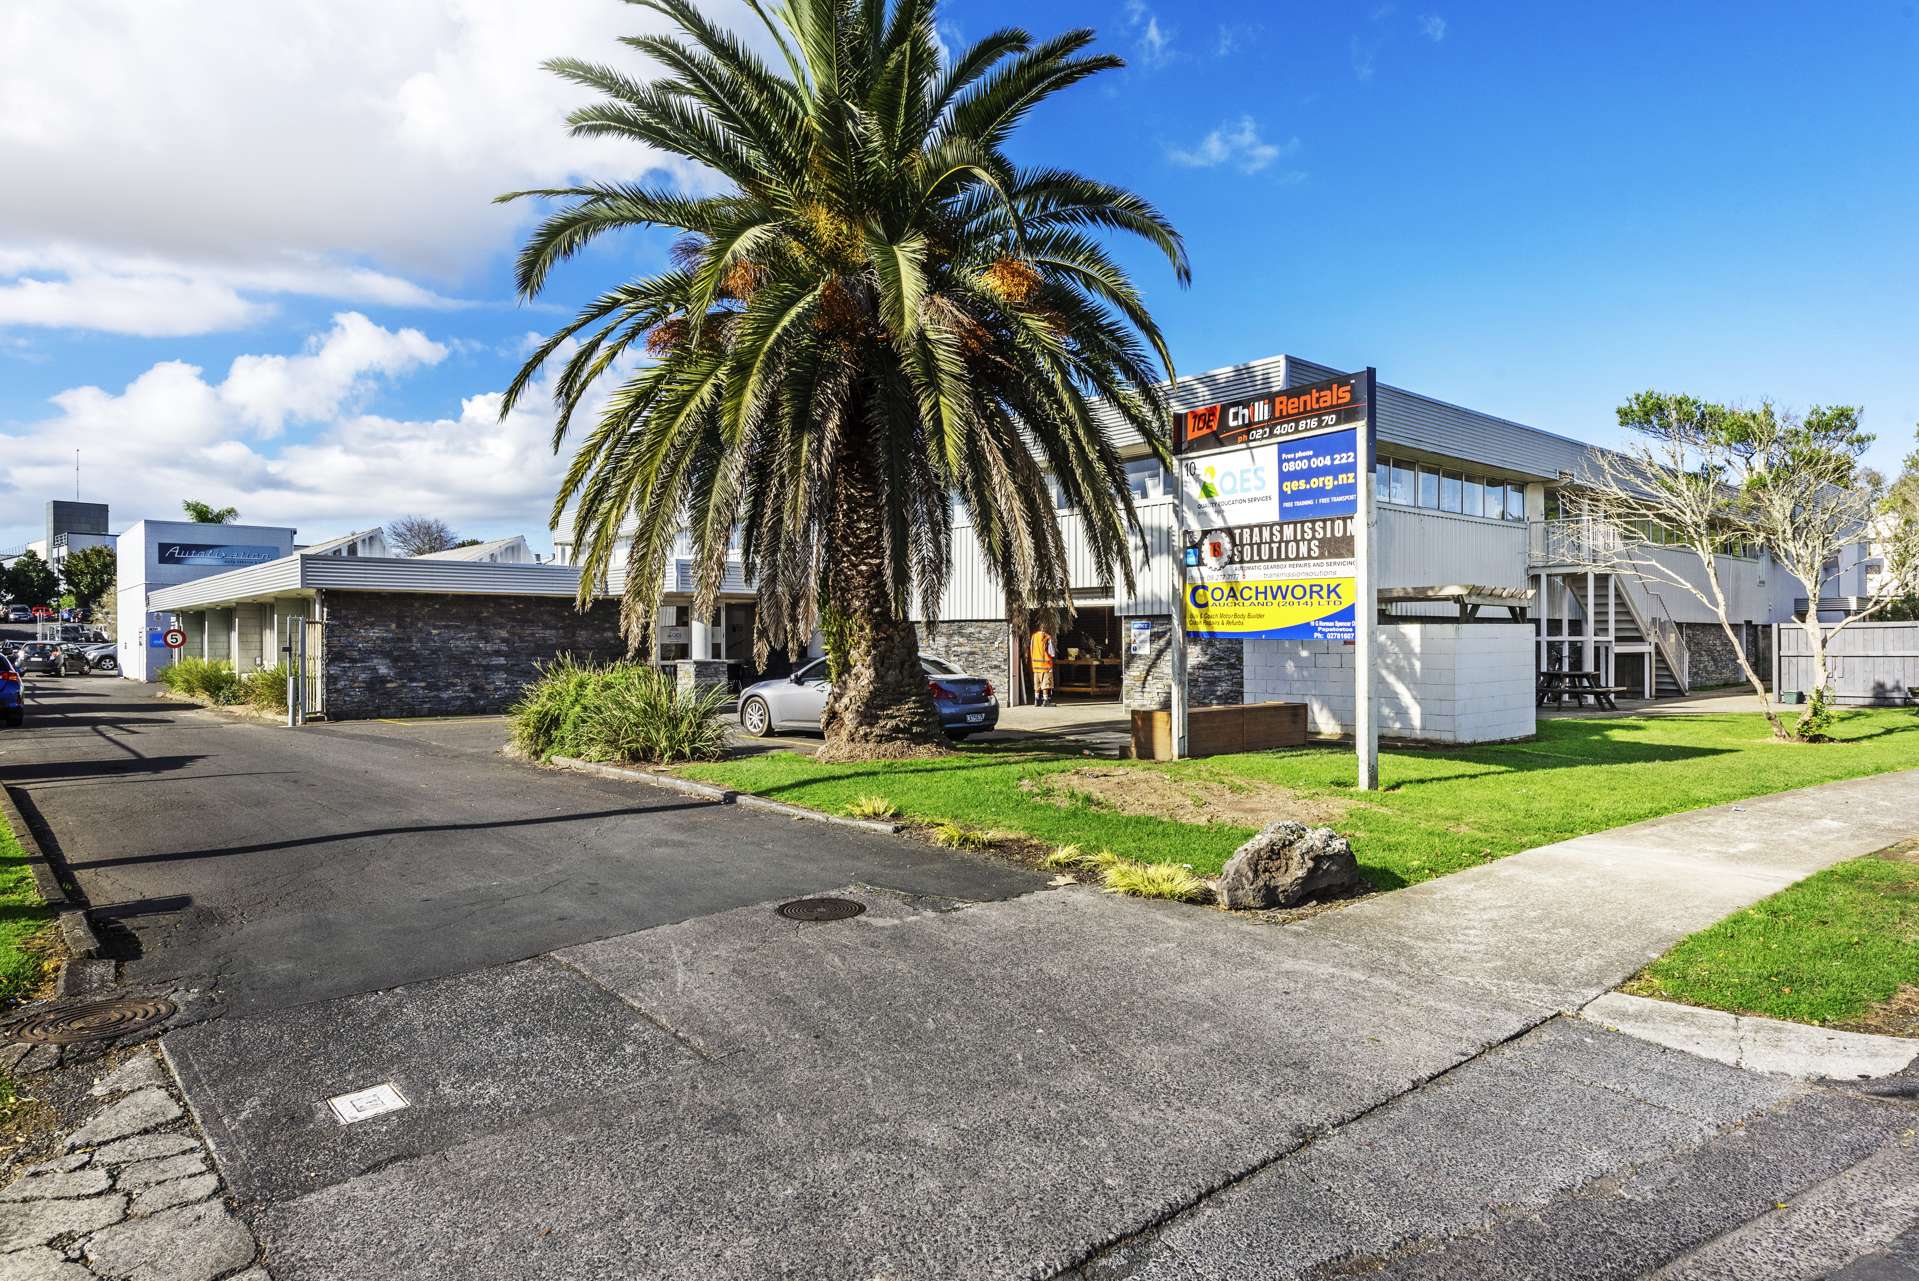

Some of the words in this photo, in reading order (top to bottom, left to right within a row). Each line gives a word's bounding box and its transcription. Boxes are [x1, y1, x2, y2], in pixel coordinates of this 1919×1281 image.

[1228, 399, 1269, 427] Chilli
[1275, 383, 1351, 417] Rentals
[1238, 434, 1248, 443] ph
[1274, 422, 1295, 435] 400
[1298, 418, 1318, 430] 816
[1321, 414, 1336, 426] 70
[1282, 459, 1308, 472] 0800
[1310, 455, 1331, 468] 004
[1333, 452, 1355, 464] 222
[1295, 450, 1313, 459] phone
[1184, 461, 1196, 476] 10
[1220, 466, 1266, 495] QES
[1282, 473, 1355, 494] qes.org.nz
[1233, 518, 1355, 544] TRANSMISSION
[1233, 540, 1319, 561] SOLUTIONS
[1190, 583, 1342, 608] COACHWORK
[1234, 612, 1246, 620] Body
[170, 634, 179, 644] 5
